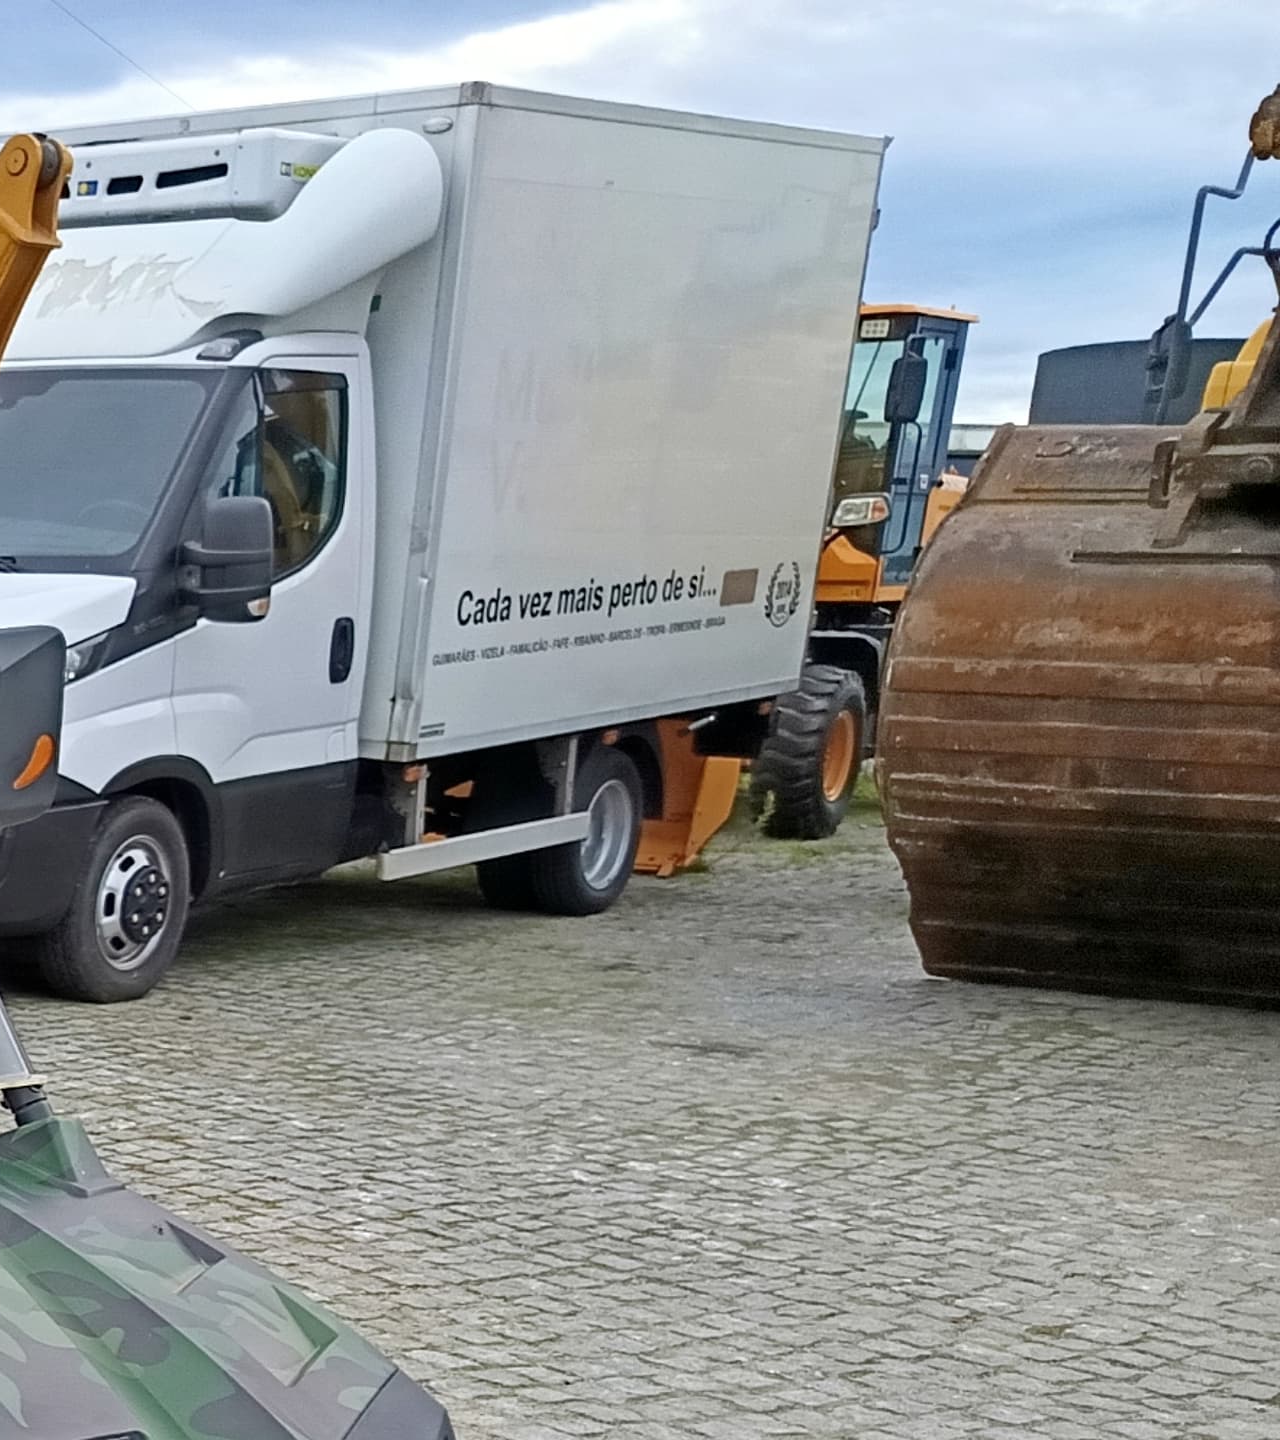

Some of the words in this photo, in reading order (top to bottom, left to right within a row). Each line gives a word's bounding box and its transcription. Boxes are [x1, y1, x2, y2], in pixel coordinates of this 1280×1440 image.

[457, 588, 511, 626] Cada
[519, 591, 552, 619] vez
[557, 578, 604, 615] mais
[608, 574, 657, 617] perto
[662, 569, 683, 601] de
[688, 566, 717, 599] si...
